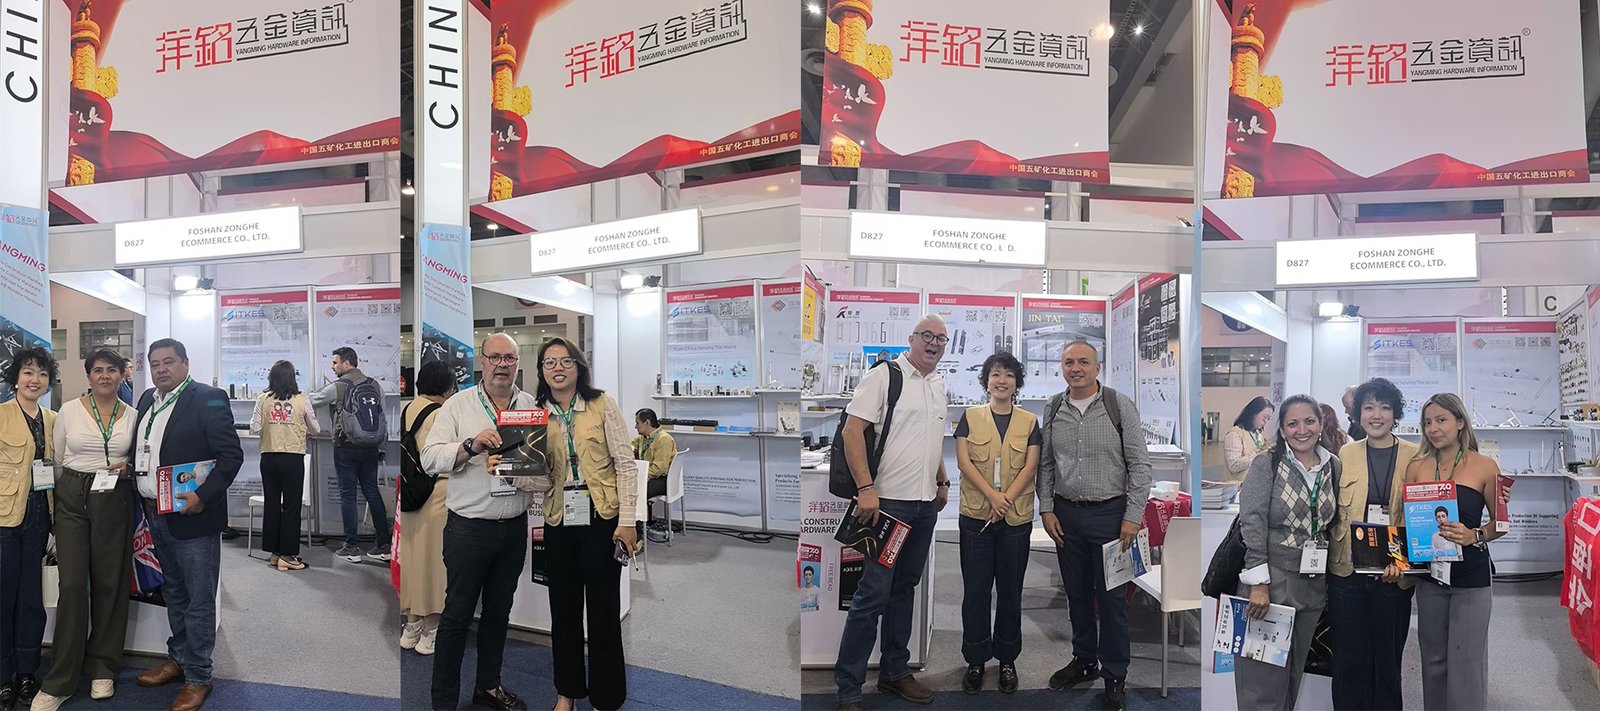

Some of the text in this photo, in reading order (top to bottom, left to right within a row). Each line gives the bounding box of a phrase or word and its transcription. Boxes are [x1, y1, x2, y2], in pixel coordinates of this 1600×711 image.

[5, 0, 38, 103] CHI
[236, 33, 341, 55] YANGMING HARDWARE INFORMATION
[637, 29, 740, 62] YANGMING HARDWARE INFORMATION
[429, 5, 459, 129] CHIN
[984, 56, 1083, 71] YANGMING HARDWARE INFORMATION
[1411, 64, 1517, 76] YANGMING HARDWARE INFORMATION
[300, 137, 399, 155] 中国五矿化工进出口商会
[699, 130, 799, 157] 中国五矿化工进出口商会
[1009, 163, 1099, 178] 中国五矿化工进出口商会
[1477, 169, 1576, 182] 中国五矿化工进出口商会
[188, 222, 260, 236] FOSHAN ZONGHE
[595, 227, 661, 243] FOSHAN ZONGHE
[860, 231, 883, 240] D827
[933, 229, 1007, 241] FOSHAN ZONGHE
[124, 239, 145, 248] D827
[181, 233, 270, 248] ECOMMERCE CO., LTD.
[588, 242, 635, 254] ECOMMERCE
[653, 236, 670, 246] LTD.
[924, 240, 979, 250] ECOMMERCE
[0, 242, 46, 272] NGMING
[538, 248, 556, 257] D827
[1358, 248, 1435, 258] FOSHAN ZONGHE
[422, 255, 467, 284] ANGMING
[1286, 259, 1309, 267] D827
[1350, 258, 1446, 270] ECOMMERCE CO., LTD.
[1544, 296, 1557, 311] C
[1028, 314, 1041, 323] JIN
[805, 518, 840, 526] CONSTRU
